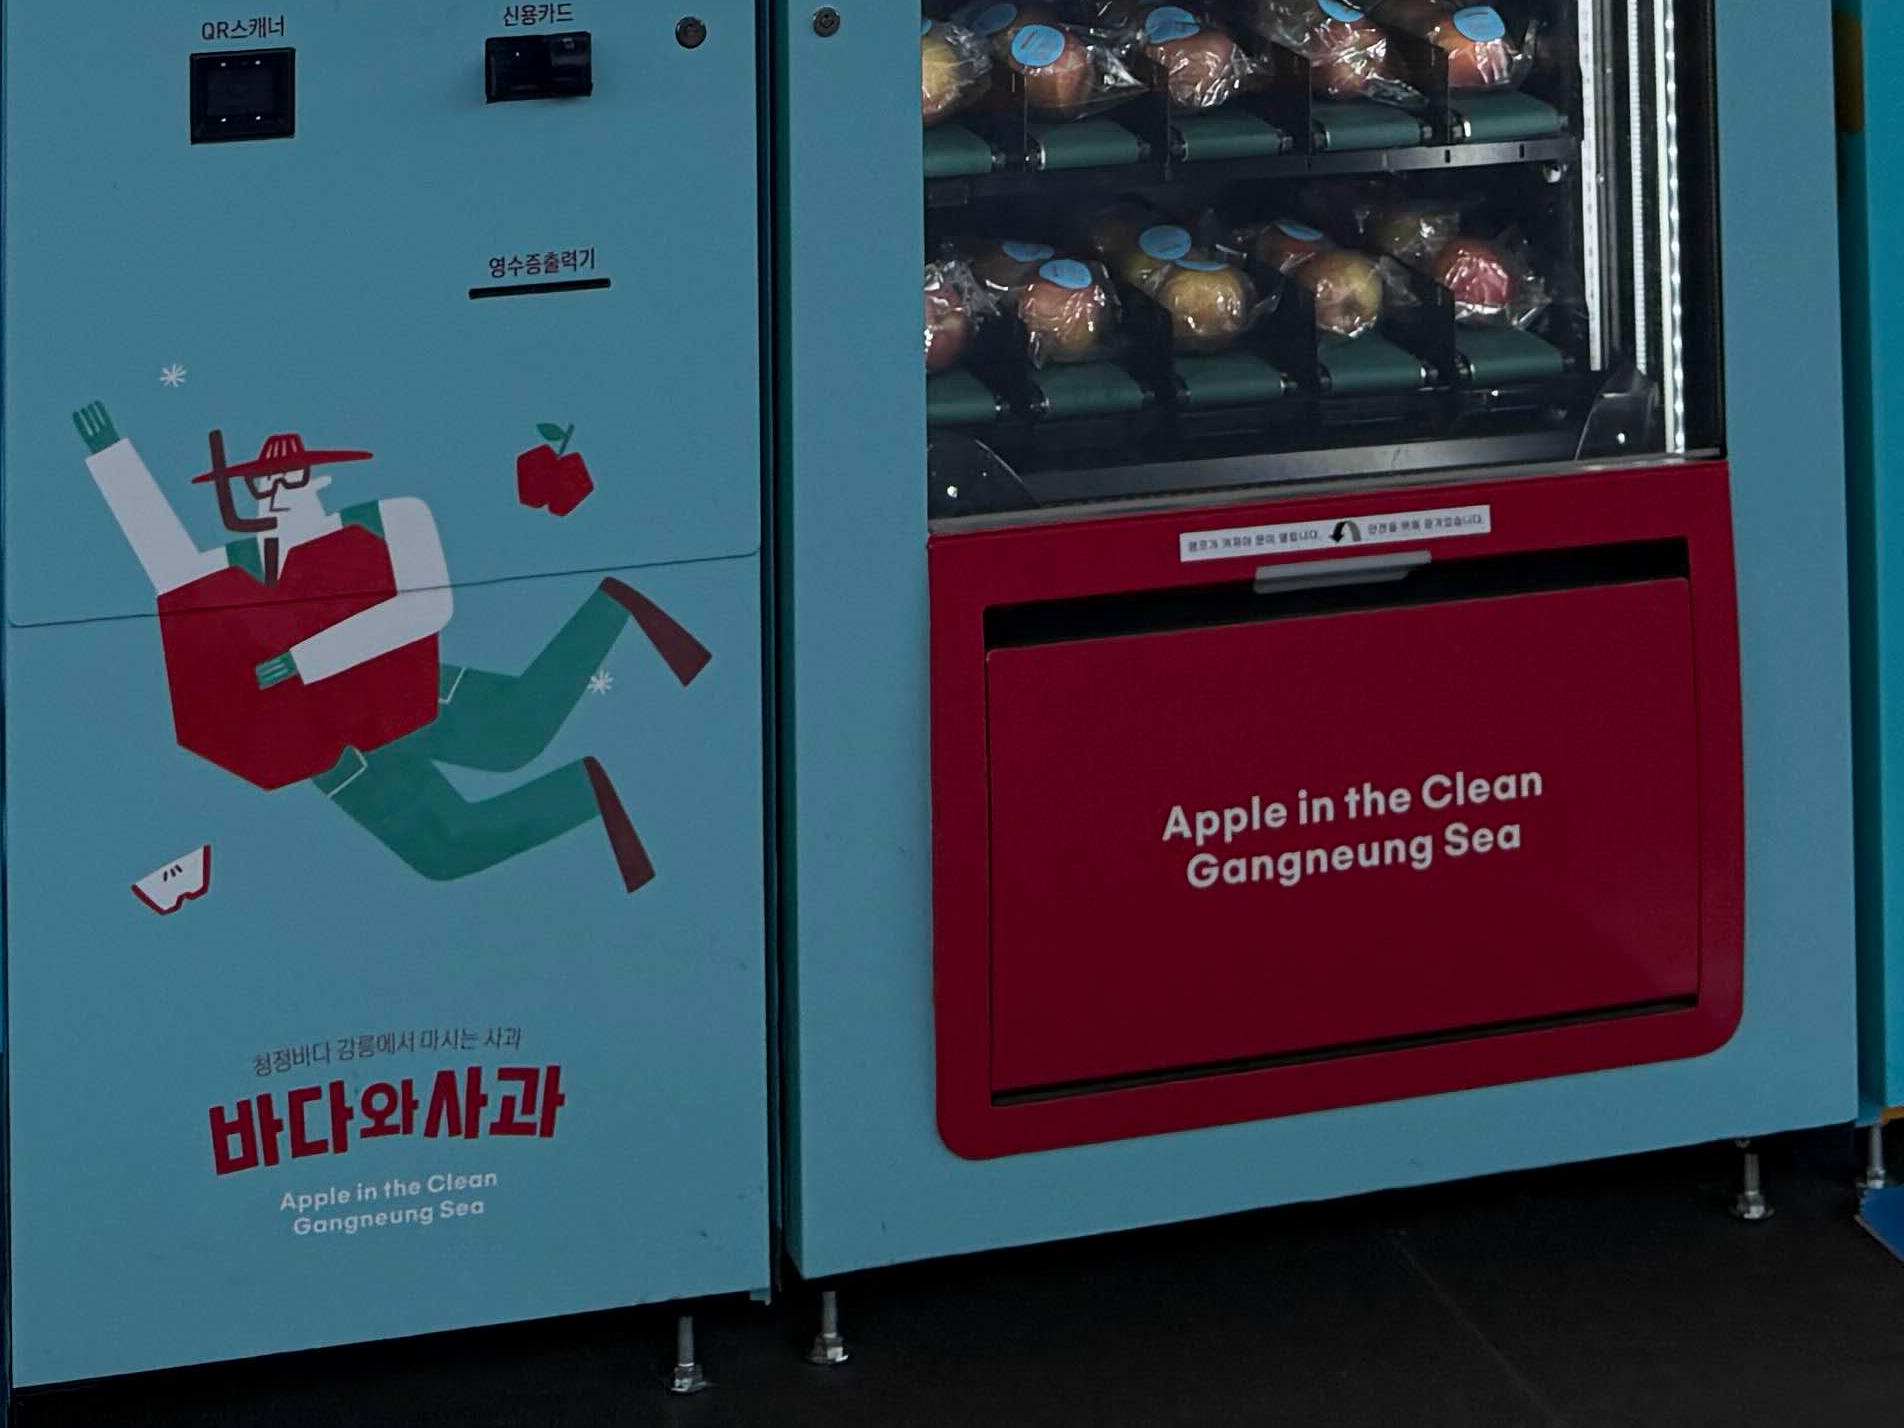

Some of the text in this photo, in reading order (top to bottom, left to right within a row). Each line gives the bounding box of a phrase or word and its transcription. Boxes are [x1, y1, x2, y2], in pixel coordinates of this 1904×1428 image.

[201, 15, 286, 41] QR스캐너
[502, 2, 574, 27] 신용카드
[488, 246, 596, 279] 영수증출력기
[1161, 770, 1543, 846] Apple in the Clean
[1186, 822, 1522, 889] Gangneung Sea
[337, 1032, 416, 1061] 강릉에서
[419, 1026, 479, 1053] 마시는
[483, 1025, 523, 1049] 사과
[208, 1065, 566, 1176] 바다와사과
[279, 1170, 498, 1213] Apple in the Clean
[293, 1198, 485, 1236] Gangneung Sea
